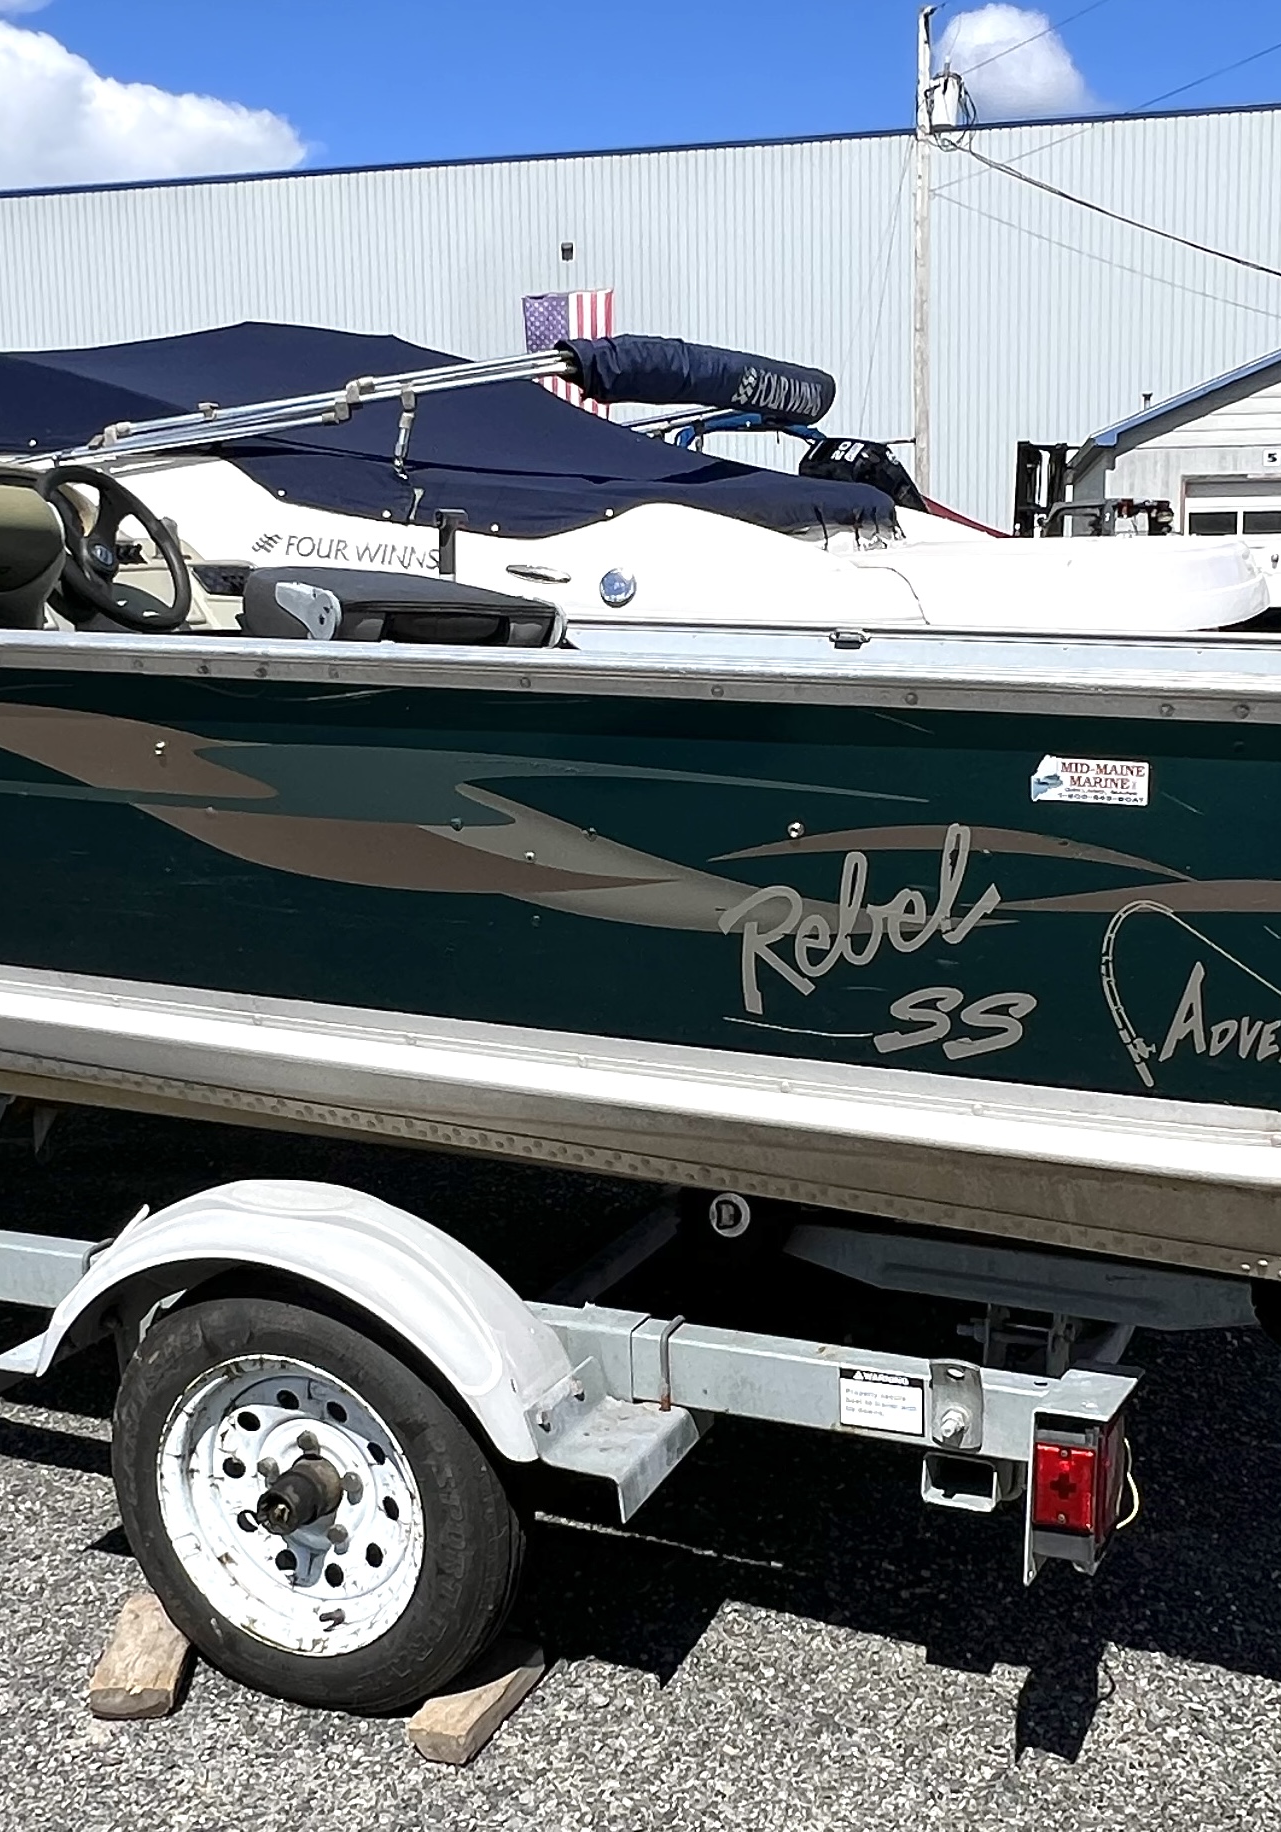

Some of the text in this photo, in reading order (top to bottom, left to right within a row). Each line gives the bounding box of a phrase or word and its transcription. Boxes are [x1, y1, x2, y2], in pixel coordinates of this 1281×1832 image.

[1267, 452, 1278, 463] 5
[285, 535, 440, 570] FOUR WINNS
[1061, 762, 1146, 777] MID-MAINE
[1070, 775, 1130, 790] MARINE
[718, 823, 1001, 1015] Rebel
[873, 986, 1038, 1060] SS
